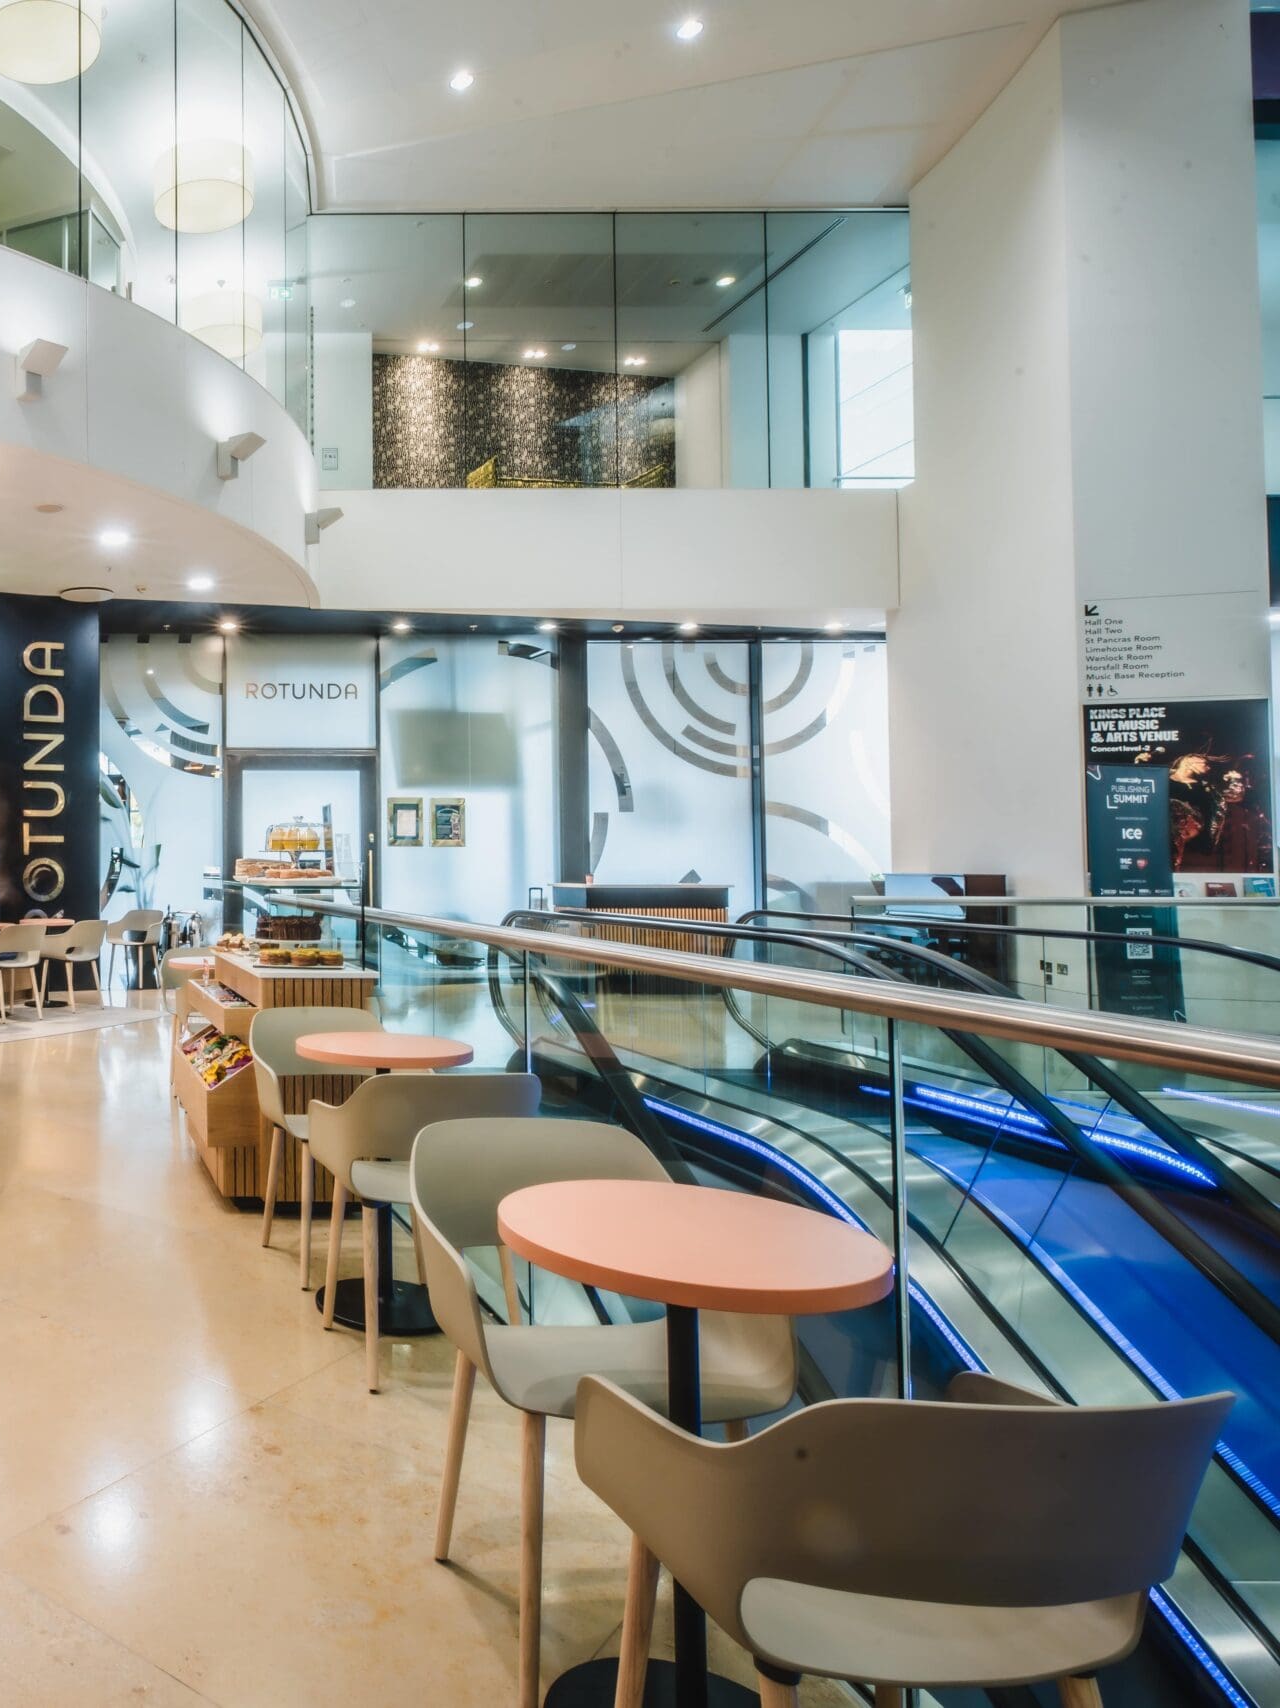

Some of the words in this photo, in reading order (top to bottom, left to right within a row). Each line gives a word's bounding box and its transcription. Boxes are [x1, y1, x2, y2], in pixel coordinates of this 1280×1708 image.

[1097, 636, 1132, 644] Pancras
[1085, 654, 1124, 662] Wenlock
[1126, 653, 1153, 661] Room
[1086, 663, 1120, 671] Horsfall
[1114, 672, 1135, 680] Base
[1138, 671, 1185, 680] Reception
[245, 682, 358, 700] ROTUNDA
[1089, 708, 1126, 719] KINGS
[1128, 707, 1166, 718] PLACE
[1090, 720, 1116, 732] LIVE
[1118, 719, 1159, 731] MUSIC
[1090, 732, 1104, 743] &
[1106, 731, 1138, 743] ARTS
[1139, 730, 1179, 741] VENUE
[23, 641, 65, 919] OTUNDA
[1111, 784, 1150, 794] PUBLISHING
[1113, 794, 1148, 804] SUMMIT
